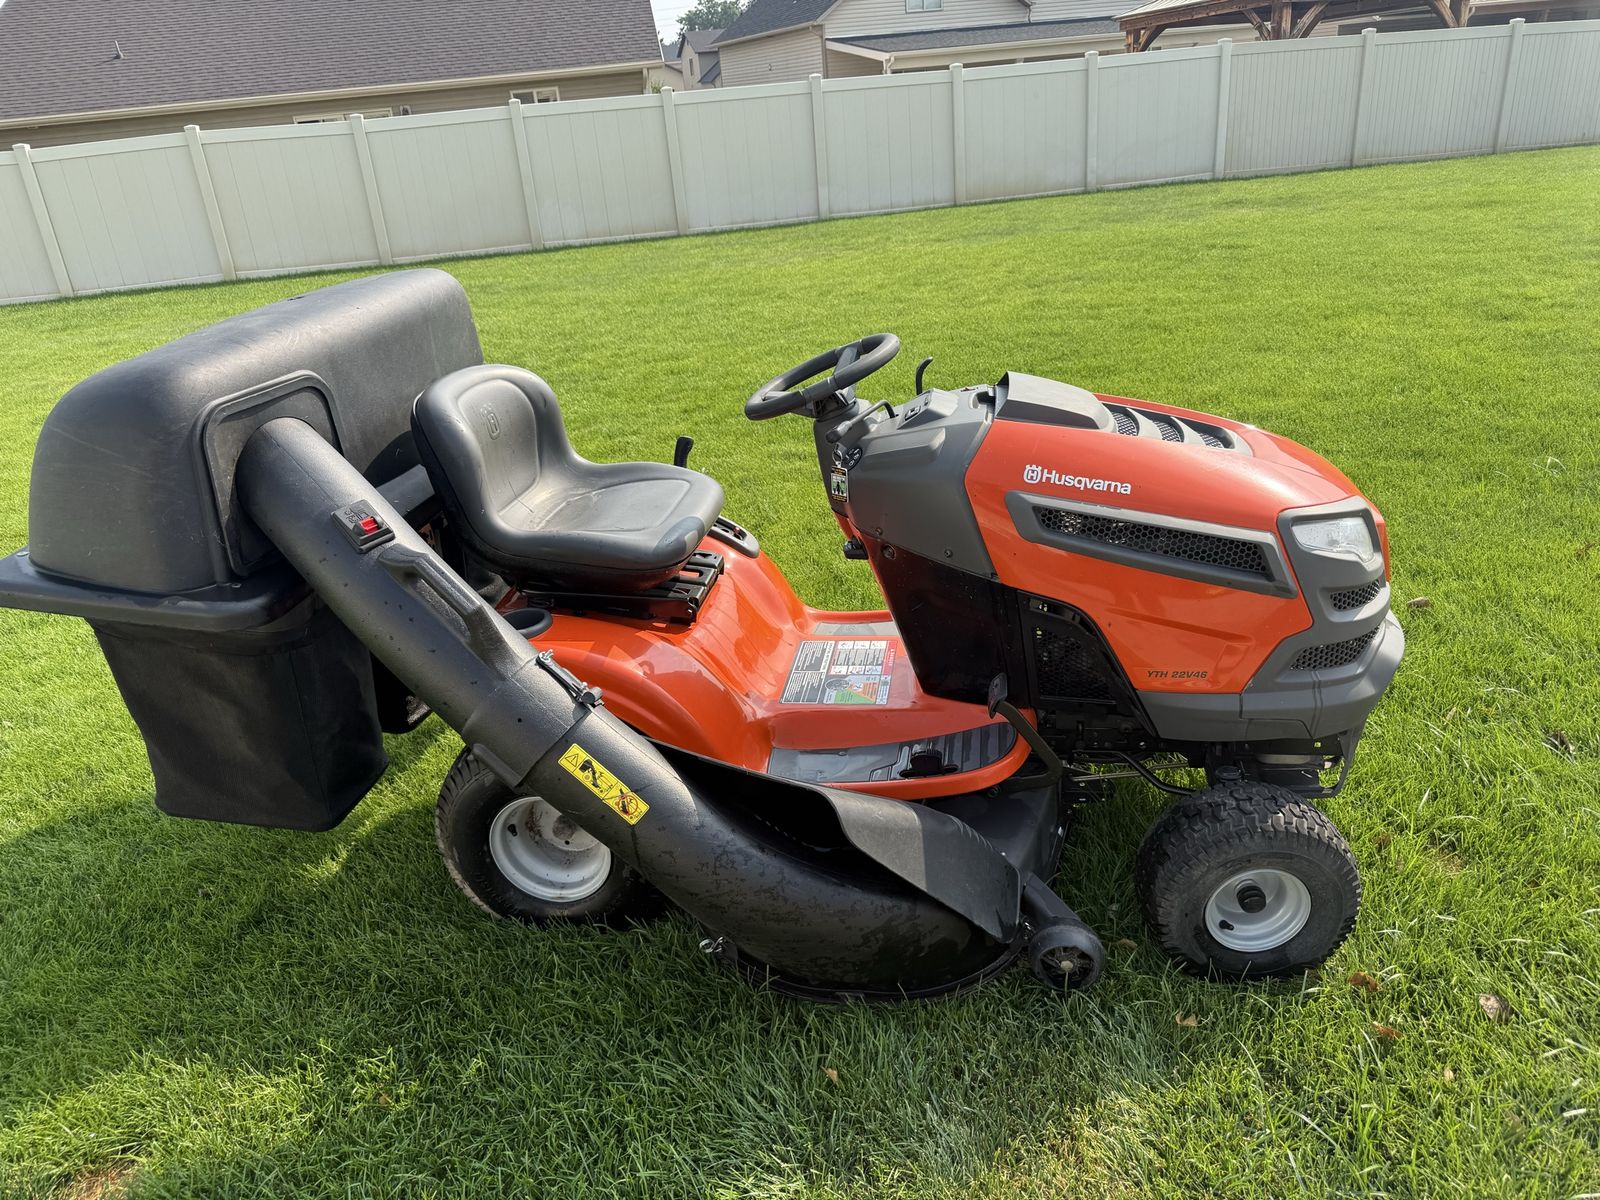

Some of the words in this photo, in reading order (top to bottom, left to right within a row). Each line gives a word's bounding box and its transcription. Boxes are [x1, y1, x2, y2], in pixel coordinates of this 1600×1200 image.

[1042, 469, 1132, 495] Husqvarna
[1147, 670, 1168, 678] YTH
[1171, 671, 1208, 679] 22V46
